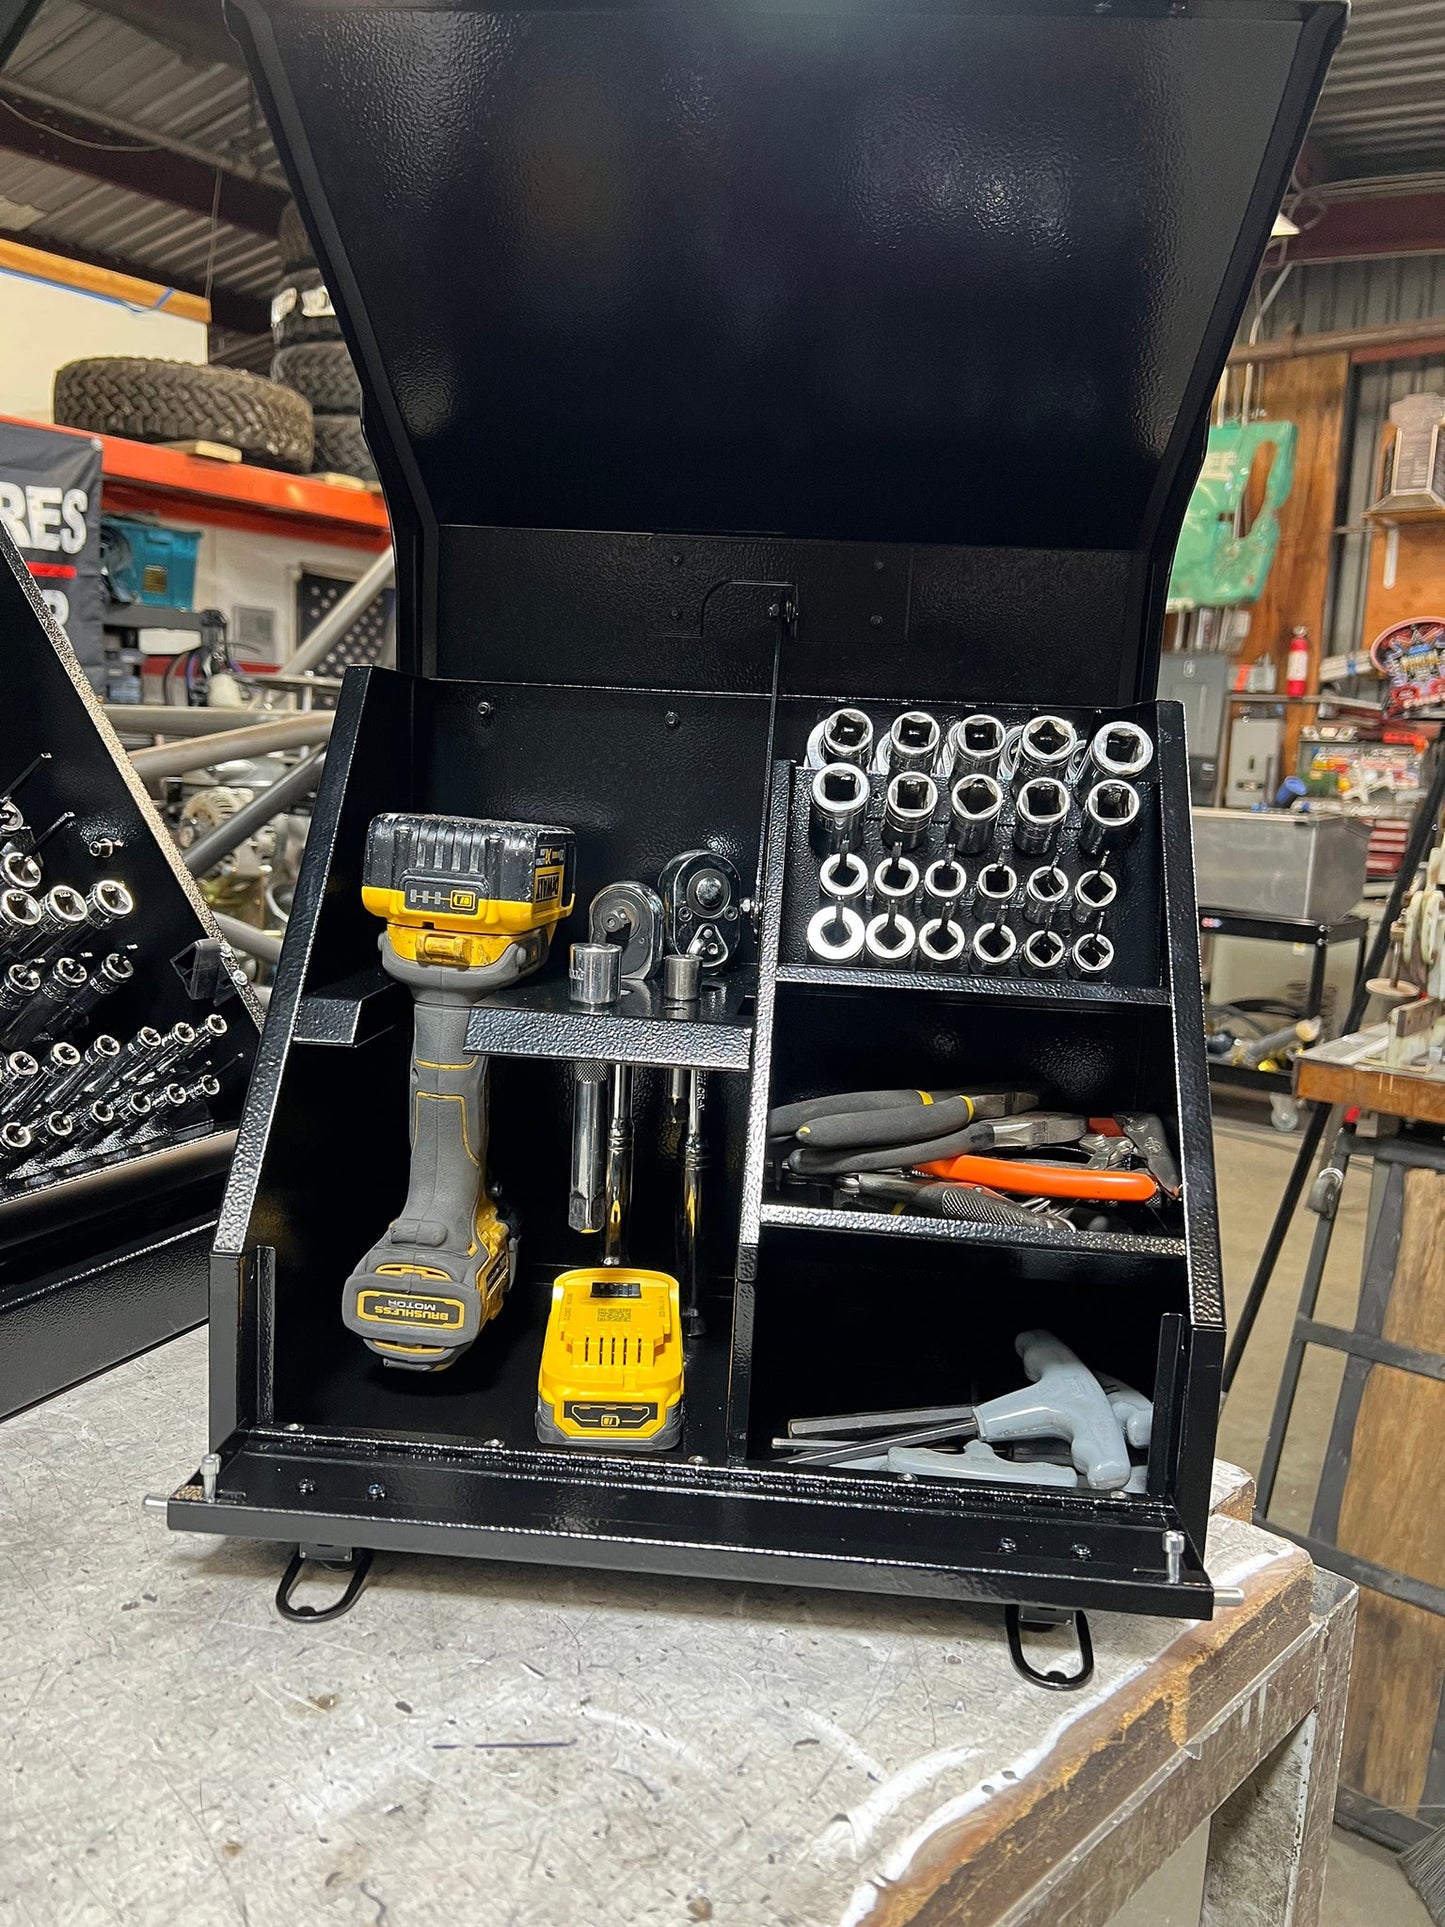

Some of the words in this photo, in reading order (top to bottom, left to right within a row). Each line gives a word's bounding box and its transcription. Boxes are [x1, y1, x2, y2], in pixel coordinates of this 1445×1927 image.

[0, 481, 88, 555] RES
[374, 1305, 449, 1321] BRUSHLESS
[387, 1299, 436, 1311] MOTOR
